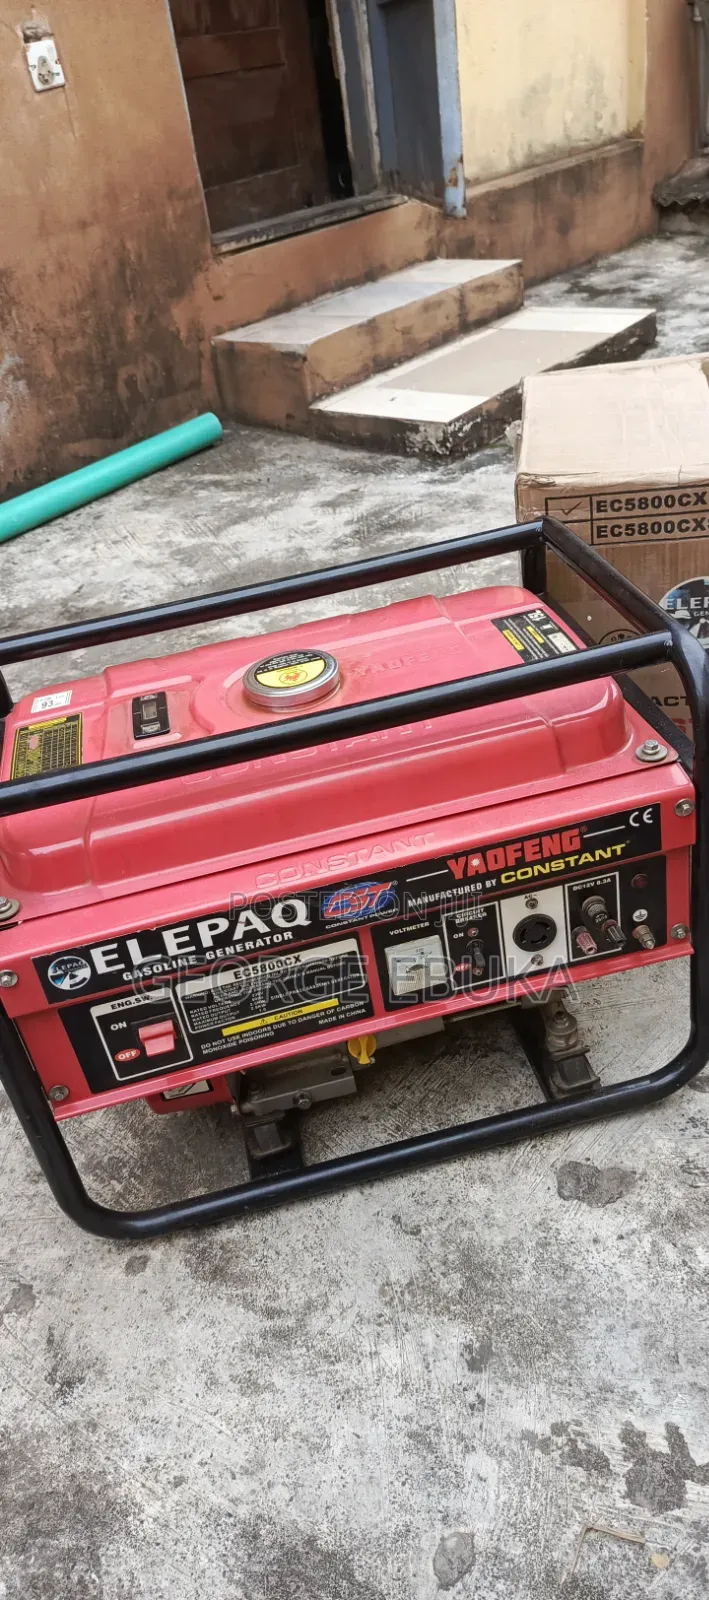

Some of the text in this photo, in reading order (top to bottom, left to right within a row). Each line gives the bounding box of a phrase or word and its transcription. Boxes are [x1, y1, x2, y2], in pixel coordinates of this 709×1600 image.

[596, 492, 707, 513] EC5800CX
[596, 517, 709, 539] EC5800CX
[255, 832, 434, 888] CONSTANT
[447, 829, 580, 880] YAOFENG
[407, 844, 626, 907] MANUFACTURED BY CONSTANT
[325, 916, 368, 929] CONSTANT
[389, 922, 430, 935] VOLTMETER
[89, 899, 312, 975] ELEPAQ
[122, 931, 294, 981] GASOLINE GENERATOR
[233, 954, 301, 979] EC5800CX
[111, 995, 153, 1010] ENG.SW.
[189, 1006, 207, 1014] RATED
[208, 1000, 231, 1009] VOLTAGE
[191, 1010, 208, 1018] RATED
[209, 1002, 240, 1013] FREQUENCY
[192, 1014, 209, 1022] RATED
[210, 1009, 231, 1018] OUTPUT
[193, 1016, 218, 1026] MAXIMUM
[219, 1010, 240, 1019] OUTPUT
[214, 1016, 236, 1025] FACTOR
[241, 1026, 271, 1038] INDOORS
[273, 1022, 286, 1030] DUE
[298, 1011, 325, 1023] DANGER
[336, 1001, 364, 1012] CARBON
[274, 1010, 303, 1020] CAUTION
[319, 1016, 337, 1025] MADE
[346, 1008, 366, 1018] CHINA
[110, 1021, 127, 1031] ON
[202, 1032, 274, 1054] MONOXIDE POISONING
[118, 1050, 137, 1060] OFF
